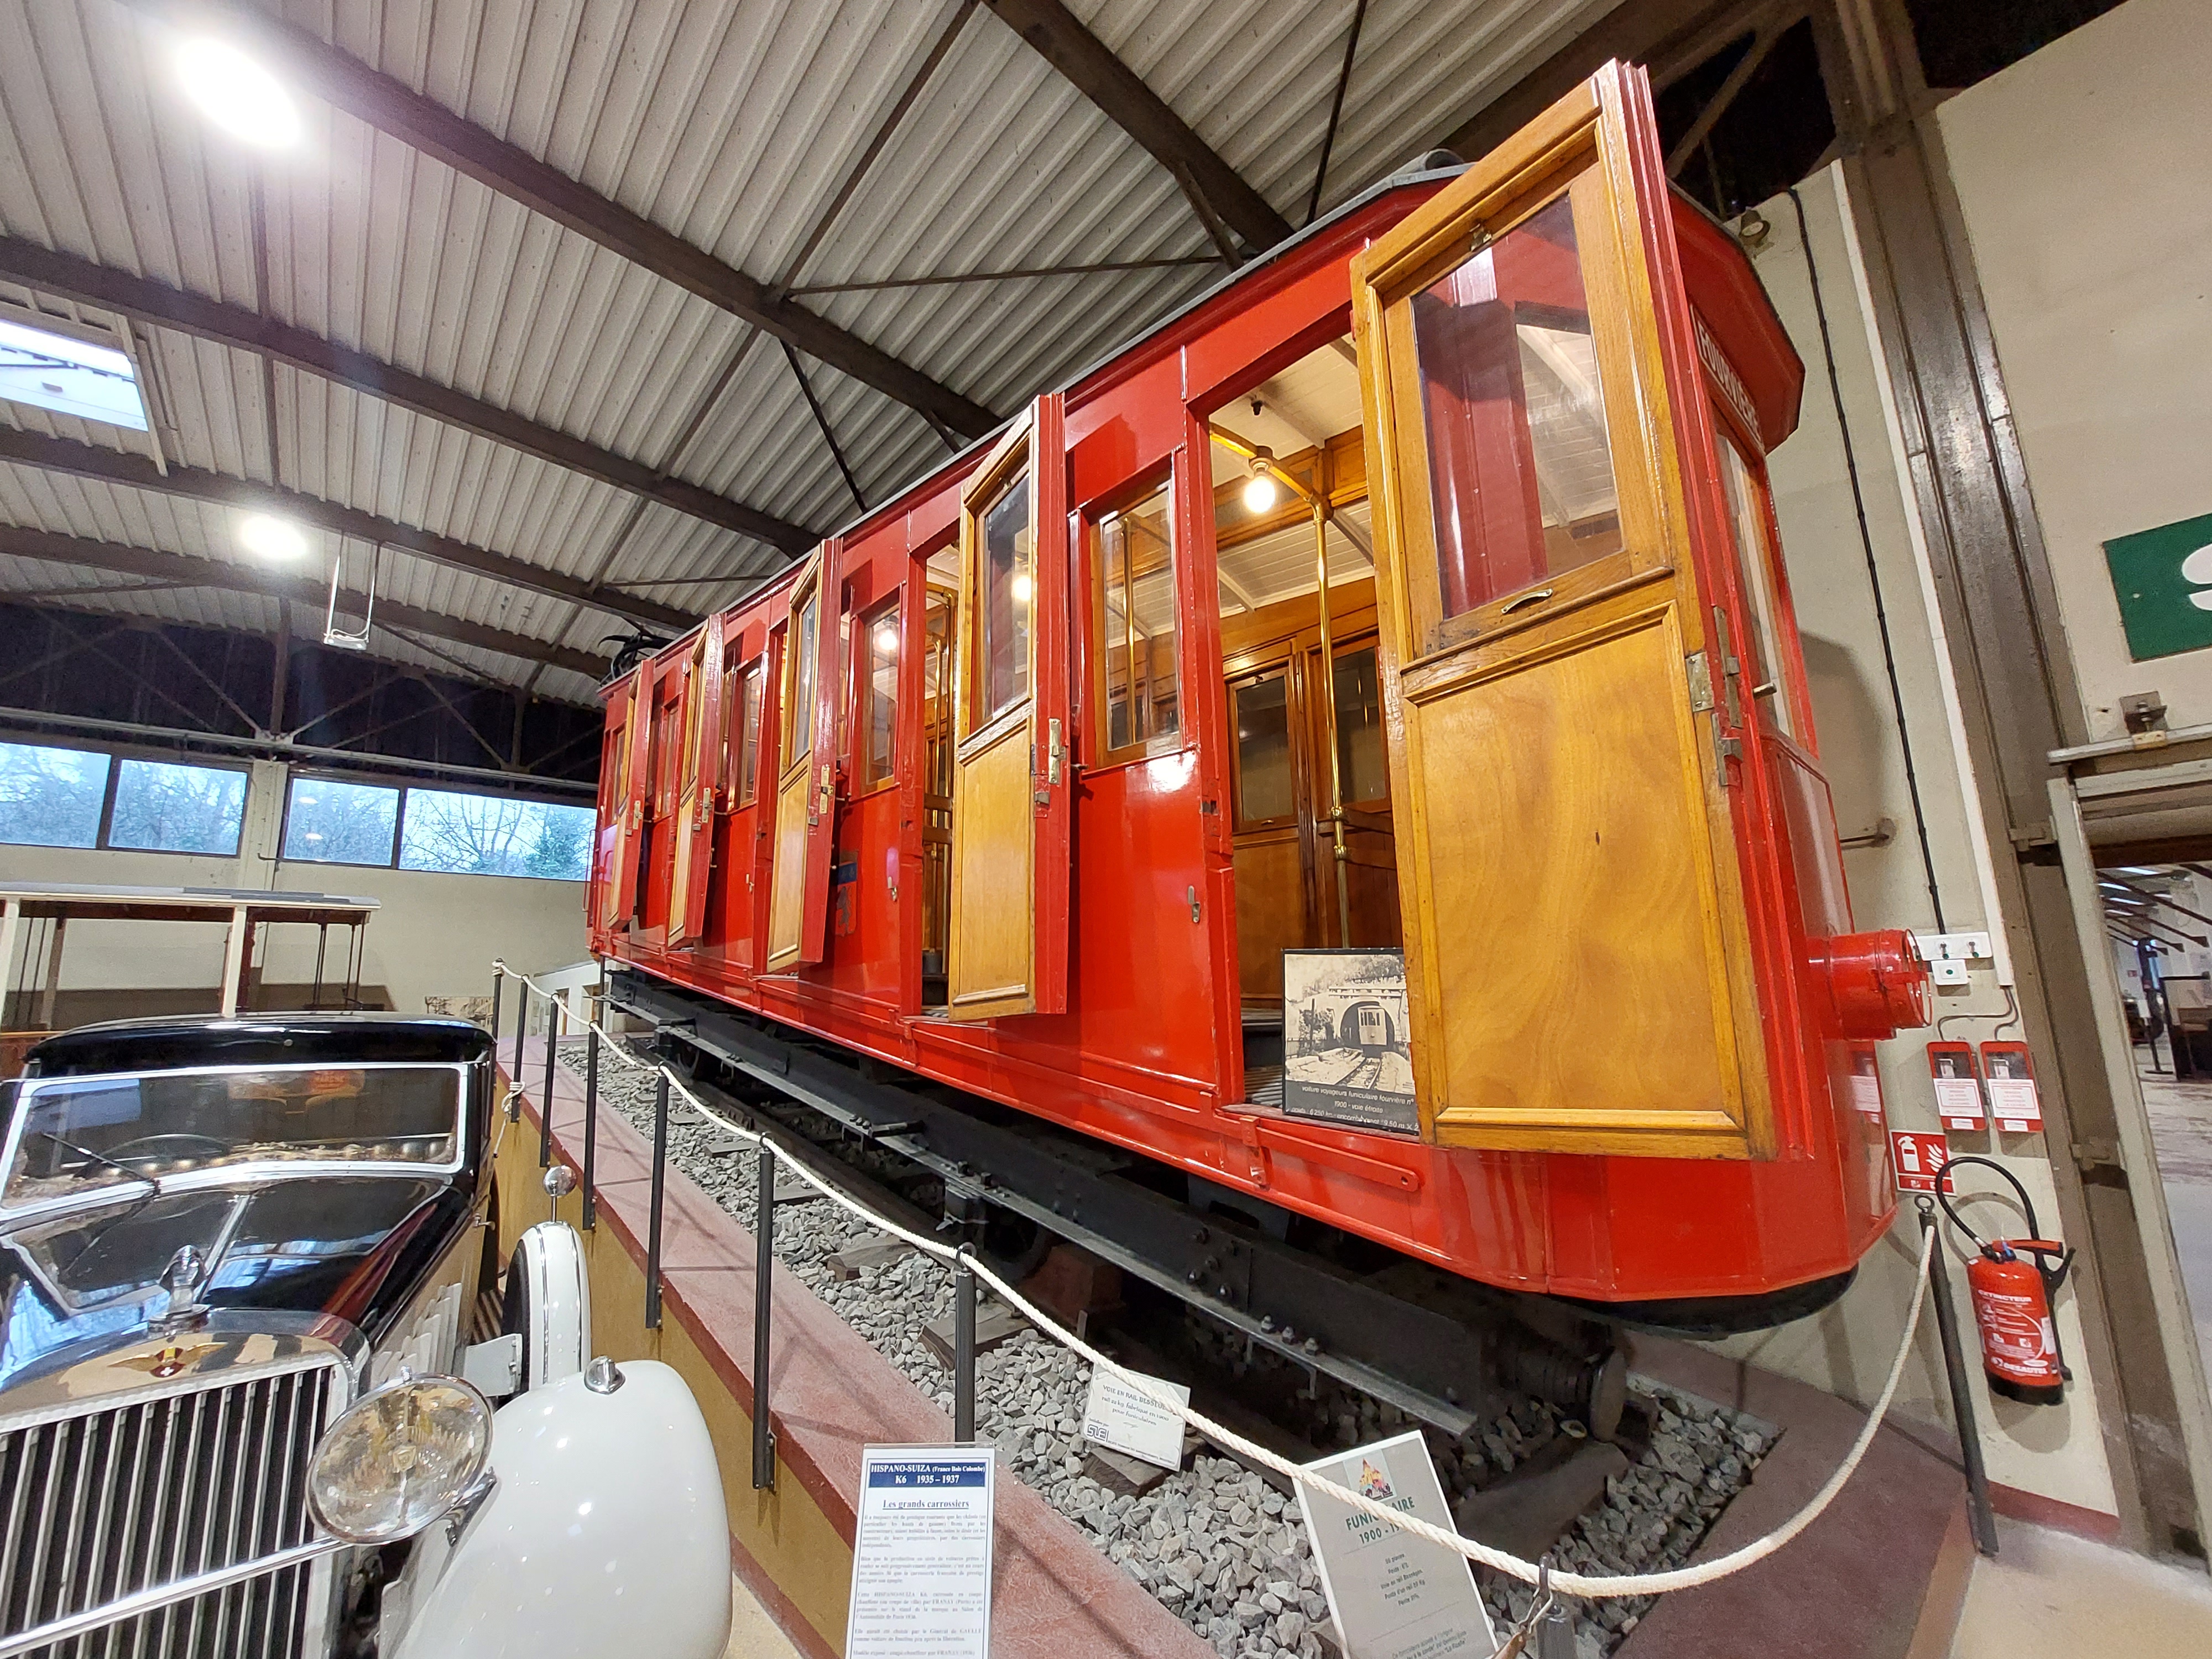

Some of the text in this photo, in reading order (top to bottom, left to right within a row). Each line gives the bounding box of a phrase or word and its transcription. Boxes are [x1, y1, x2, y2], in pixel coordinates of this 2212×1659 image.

[1320, 1088, 1347, 1097] voyageurs
[1349, 1091, 1378, 1101] funiculaire
[1379, 1094, 1406, 1104] fourvière
[1364, 1104, 1383, 1114] étroite
[1103, 1384, 1116, 1394] VOIE
[1125, 1392, 1138, 1401] RAIL
[1125, 1410, 1157, 1426] funiculaires
[1126, 1402, 1149, 1415] fabriqué
[1156, 1413, 1169, 1422] 1900
[871, 1464, 931, 1473] HISPANO-SUIZA
[895, 1475, 907, 1484] K6
[916, 1475, 935, 1484] 1935
[942, 1474, 960, 1484] 1937
[883, 1499, 969, 1509] Les grands carrossiers
[1359, 1527, 1382, 1545] 1900
